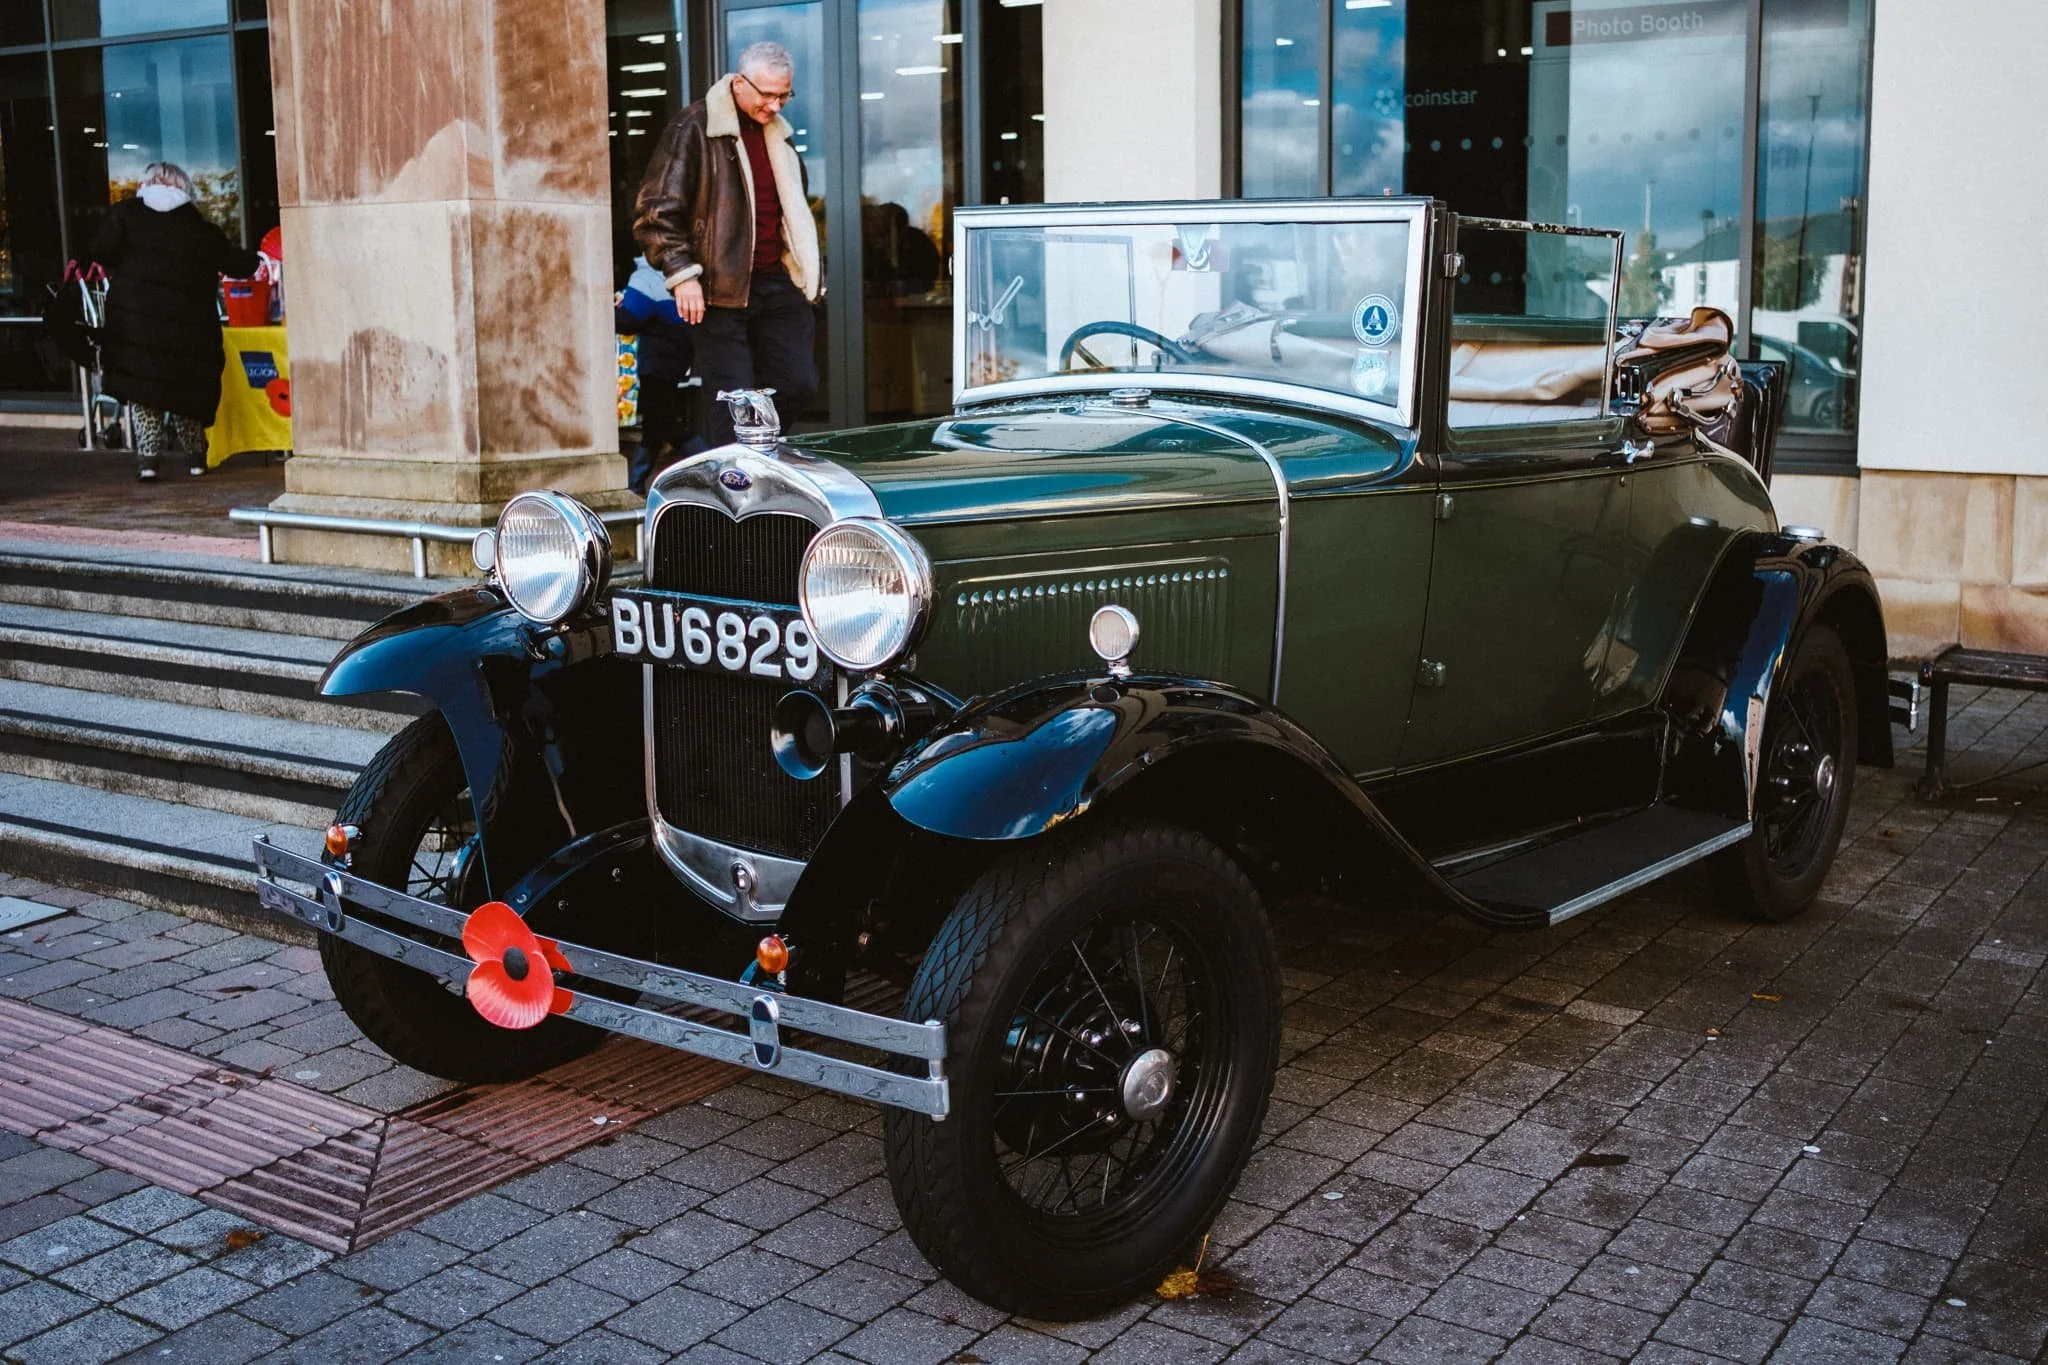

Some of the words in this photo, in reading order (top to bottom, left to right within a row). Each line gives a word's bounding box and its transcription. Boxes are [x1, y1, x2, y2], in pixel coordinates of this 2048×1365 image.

[1573, 17, 1633, 37] Photo
[1641, 11, 1704, 33] Booth
[1404, 89, 1478, 107] coinstar
[612, 597, 818, 681] BU6829
